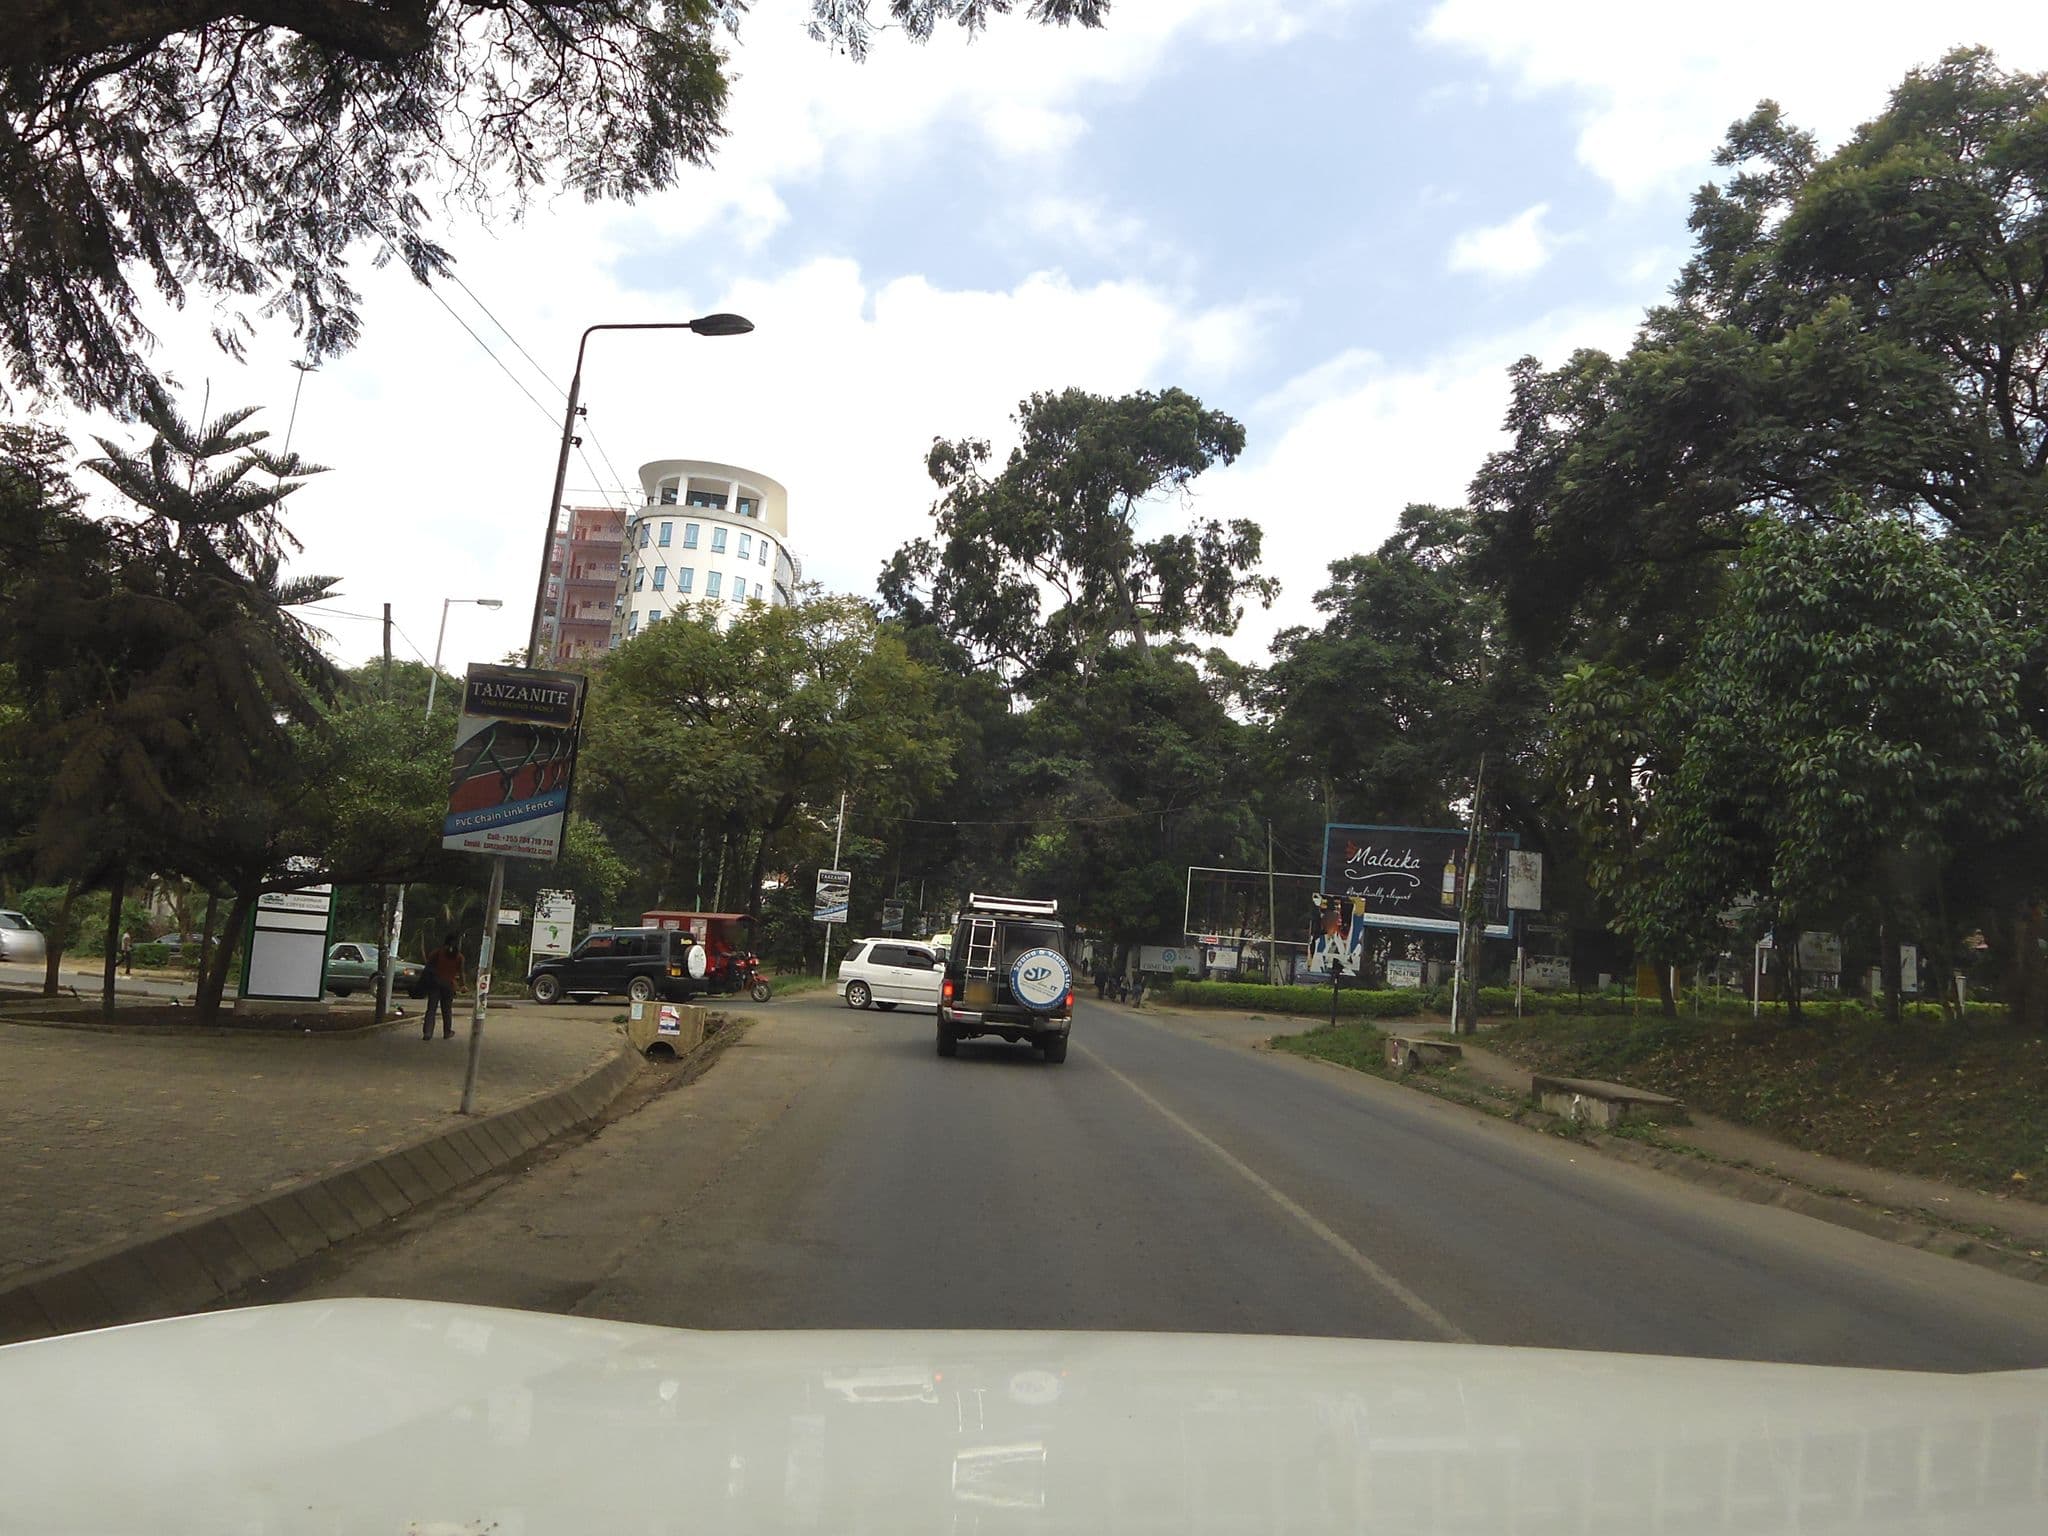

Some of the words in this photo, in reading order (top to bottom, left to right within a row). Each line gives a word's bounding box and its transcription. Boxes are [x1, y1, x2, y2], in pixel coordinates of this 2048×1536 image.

[472, 682, 569, 705] TANZANITE
[455, 817, 474, 827] PVC
[474, 812, 502, 824] Chain
[503, 806, 524, 818] Link
[525, 800, 554, 812] Fence
[1347, 846, 1421, 869] Malaika
